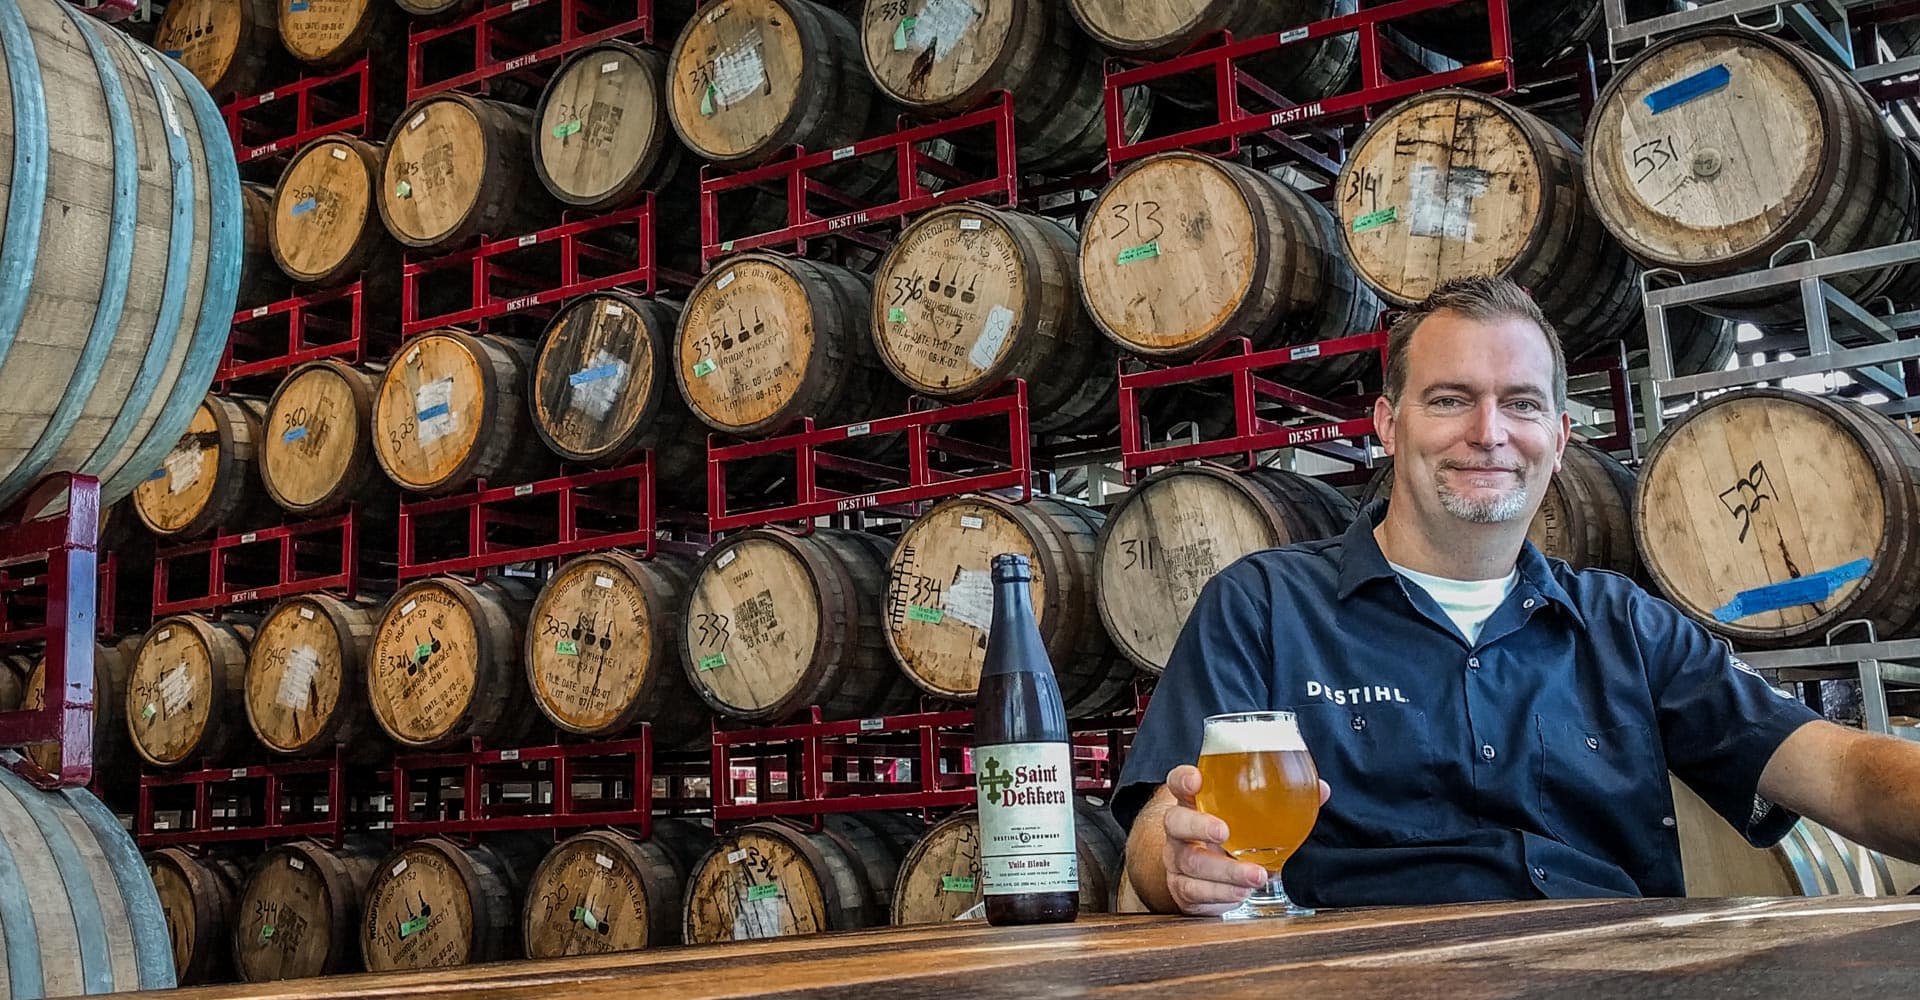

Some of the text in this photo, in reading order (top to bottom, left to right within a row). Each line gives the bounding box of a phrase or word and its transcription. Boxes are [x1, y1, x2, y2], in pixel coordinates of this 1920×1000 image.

[881, 1, 908, 22] 338
[1271, 103, 1325, 126] DESTIHL
[1633, 135, 1679, 184] 531
[1346, 167, 1377, 212] 314
[829, 212, 869, 230] DESTIHL
[1111, 201, 1164, 243] 313
[889, 270, 924, 306] 336
[507, 296, 540, 311] DESTIHL
[692, 331, 721, 362] 335
[284, 407, 307, 431] 360
[390, 416, 414, 454] 323
[1288, 425, 1343, 444] DESTIHL
[837, 495, 879, 512] DESTIHL
[1718, 460, 1779, 543] 529
[1120, 540, 1153, 570] 311
[910, 576, 942, 603] 334
[542, 615, 569, 639] 322
[697, 613, 729, 651] 333
[262, 647, 286, 672] 346
[1307, 681, 1407, 705] DESTIHL
[1015, 765, 1057, 788] Saint
[1002, 787, 1065, 808] Dekkera
[256, 900, 277, 923] 344
[542, 884, 569, 922] 320
[378, 921, 396, 955] 319
